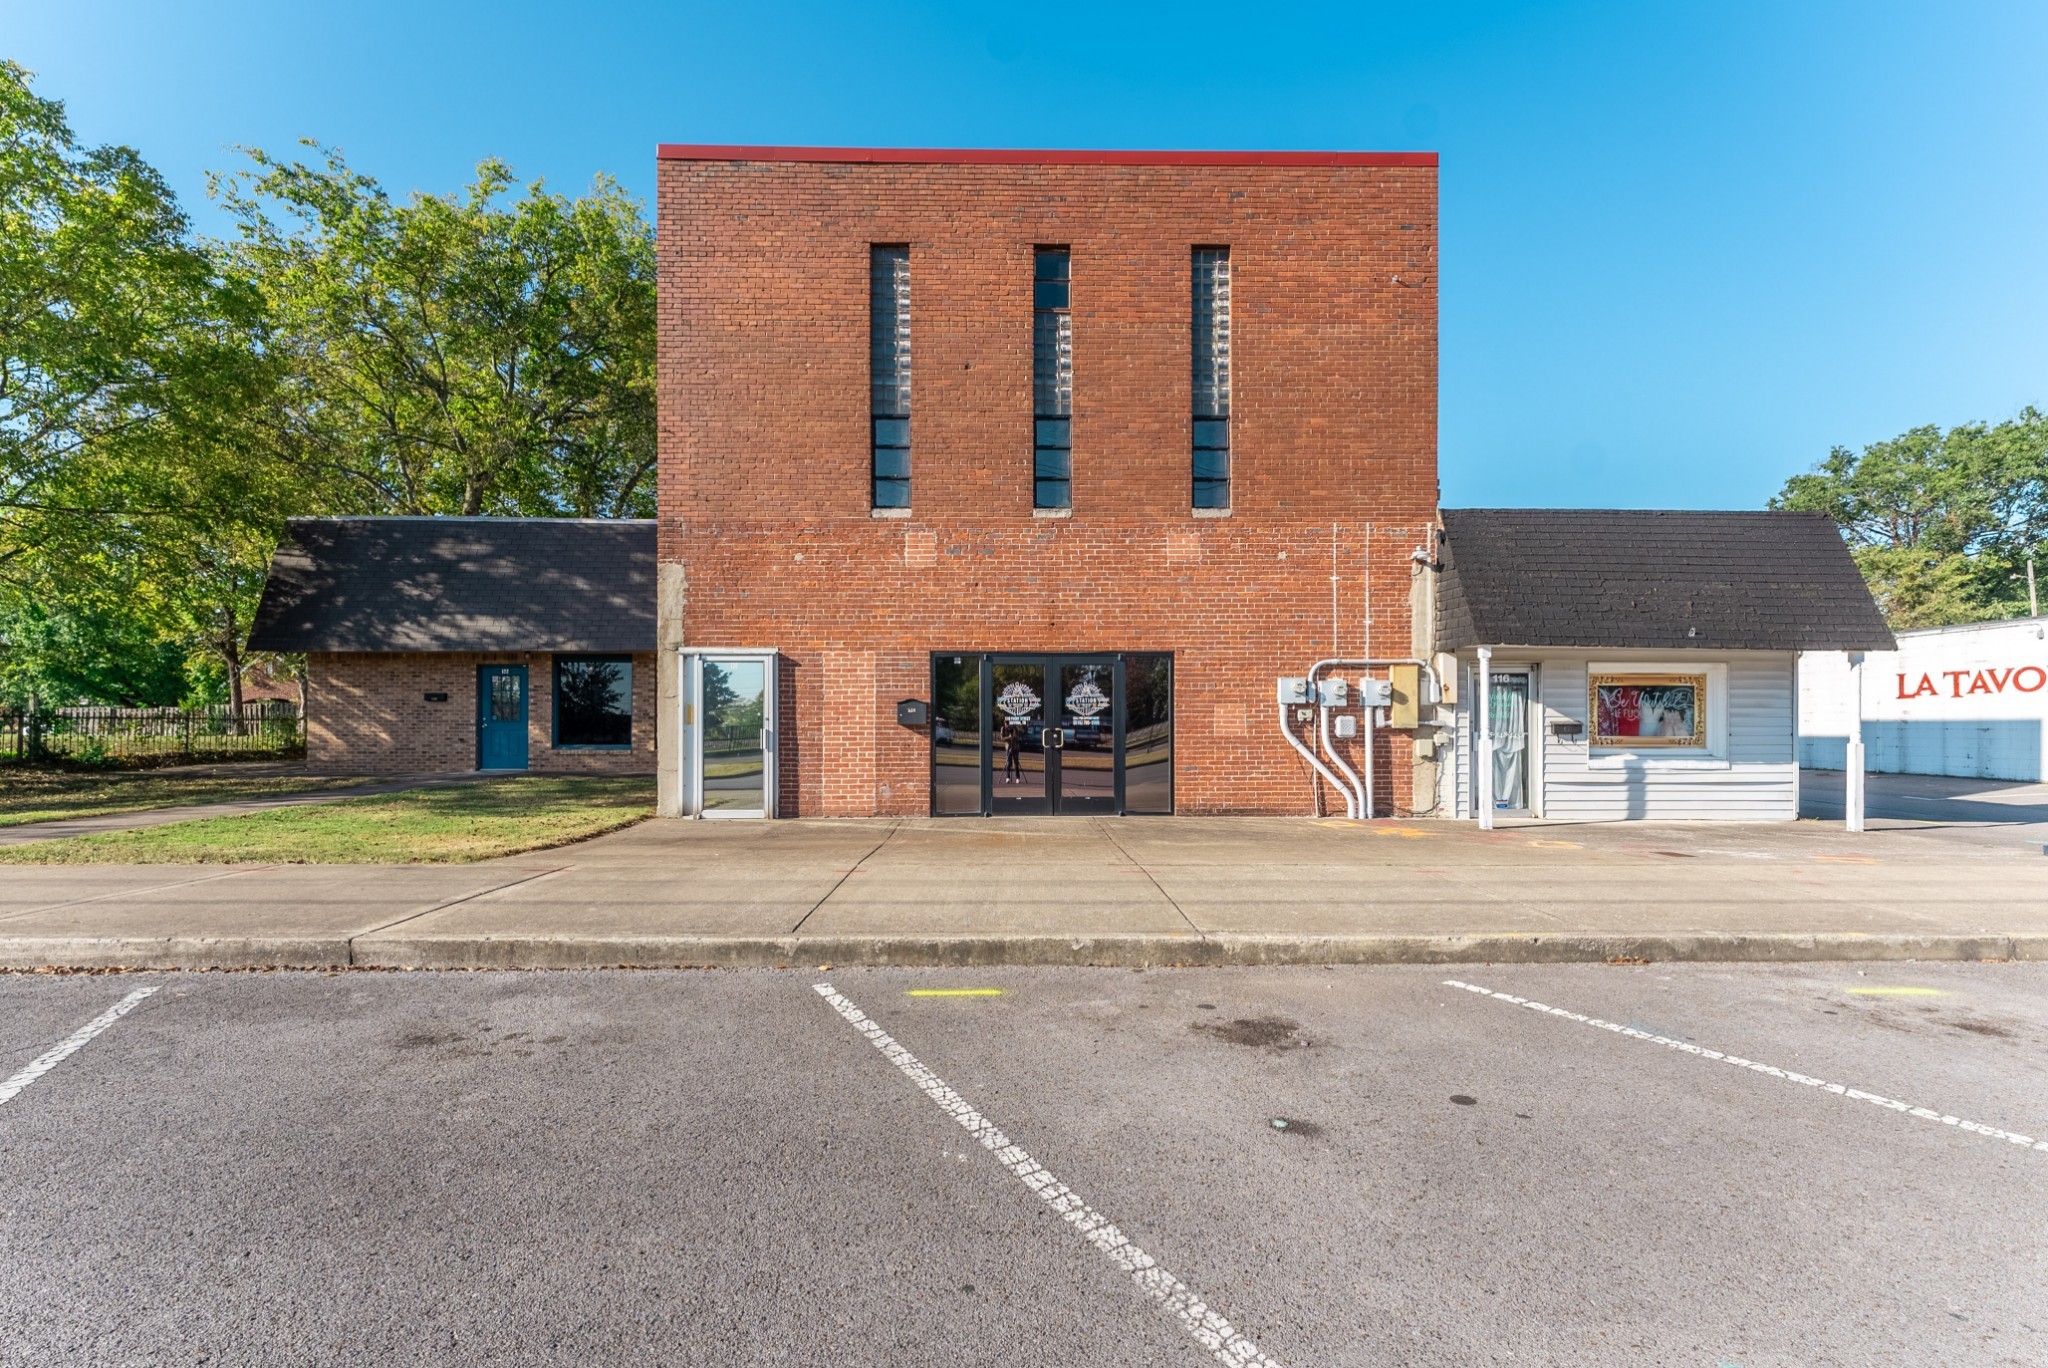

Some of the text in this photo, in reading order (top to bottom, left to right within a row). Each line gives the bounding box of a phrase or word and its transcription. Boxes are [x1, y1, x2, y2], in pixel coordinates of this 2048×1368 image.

[1492, 674, 1510, 683] 116
[1896, 665, 2048, 699] LA TAVO
